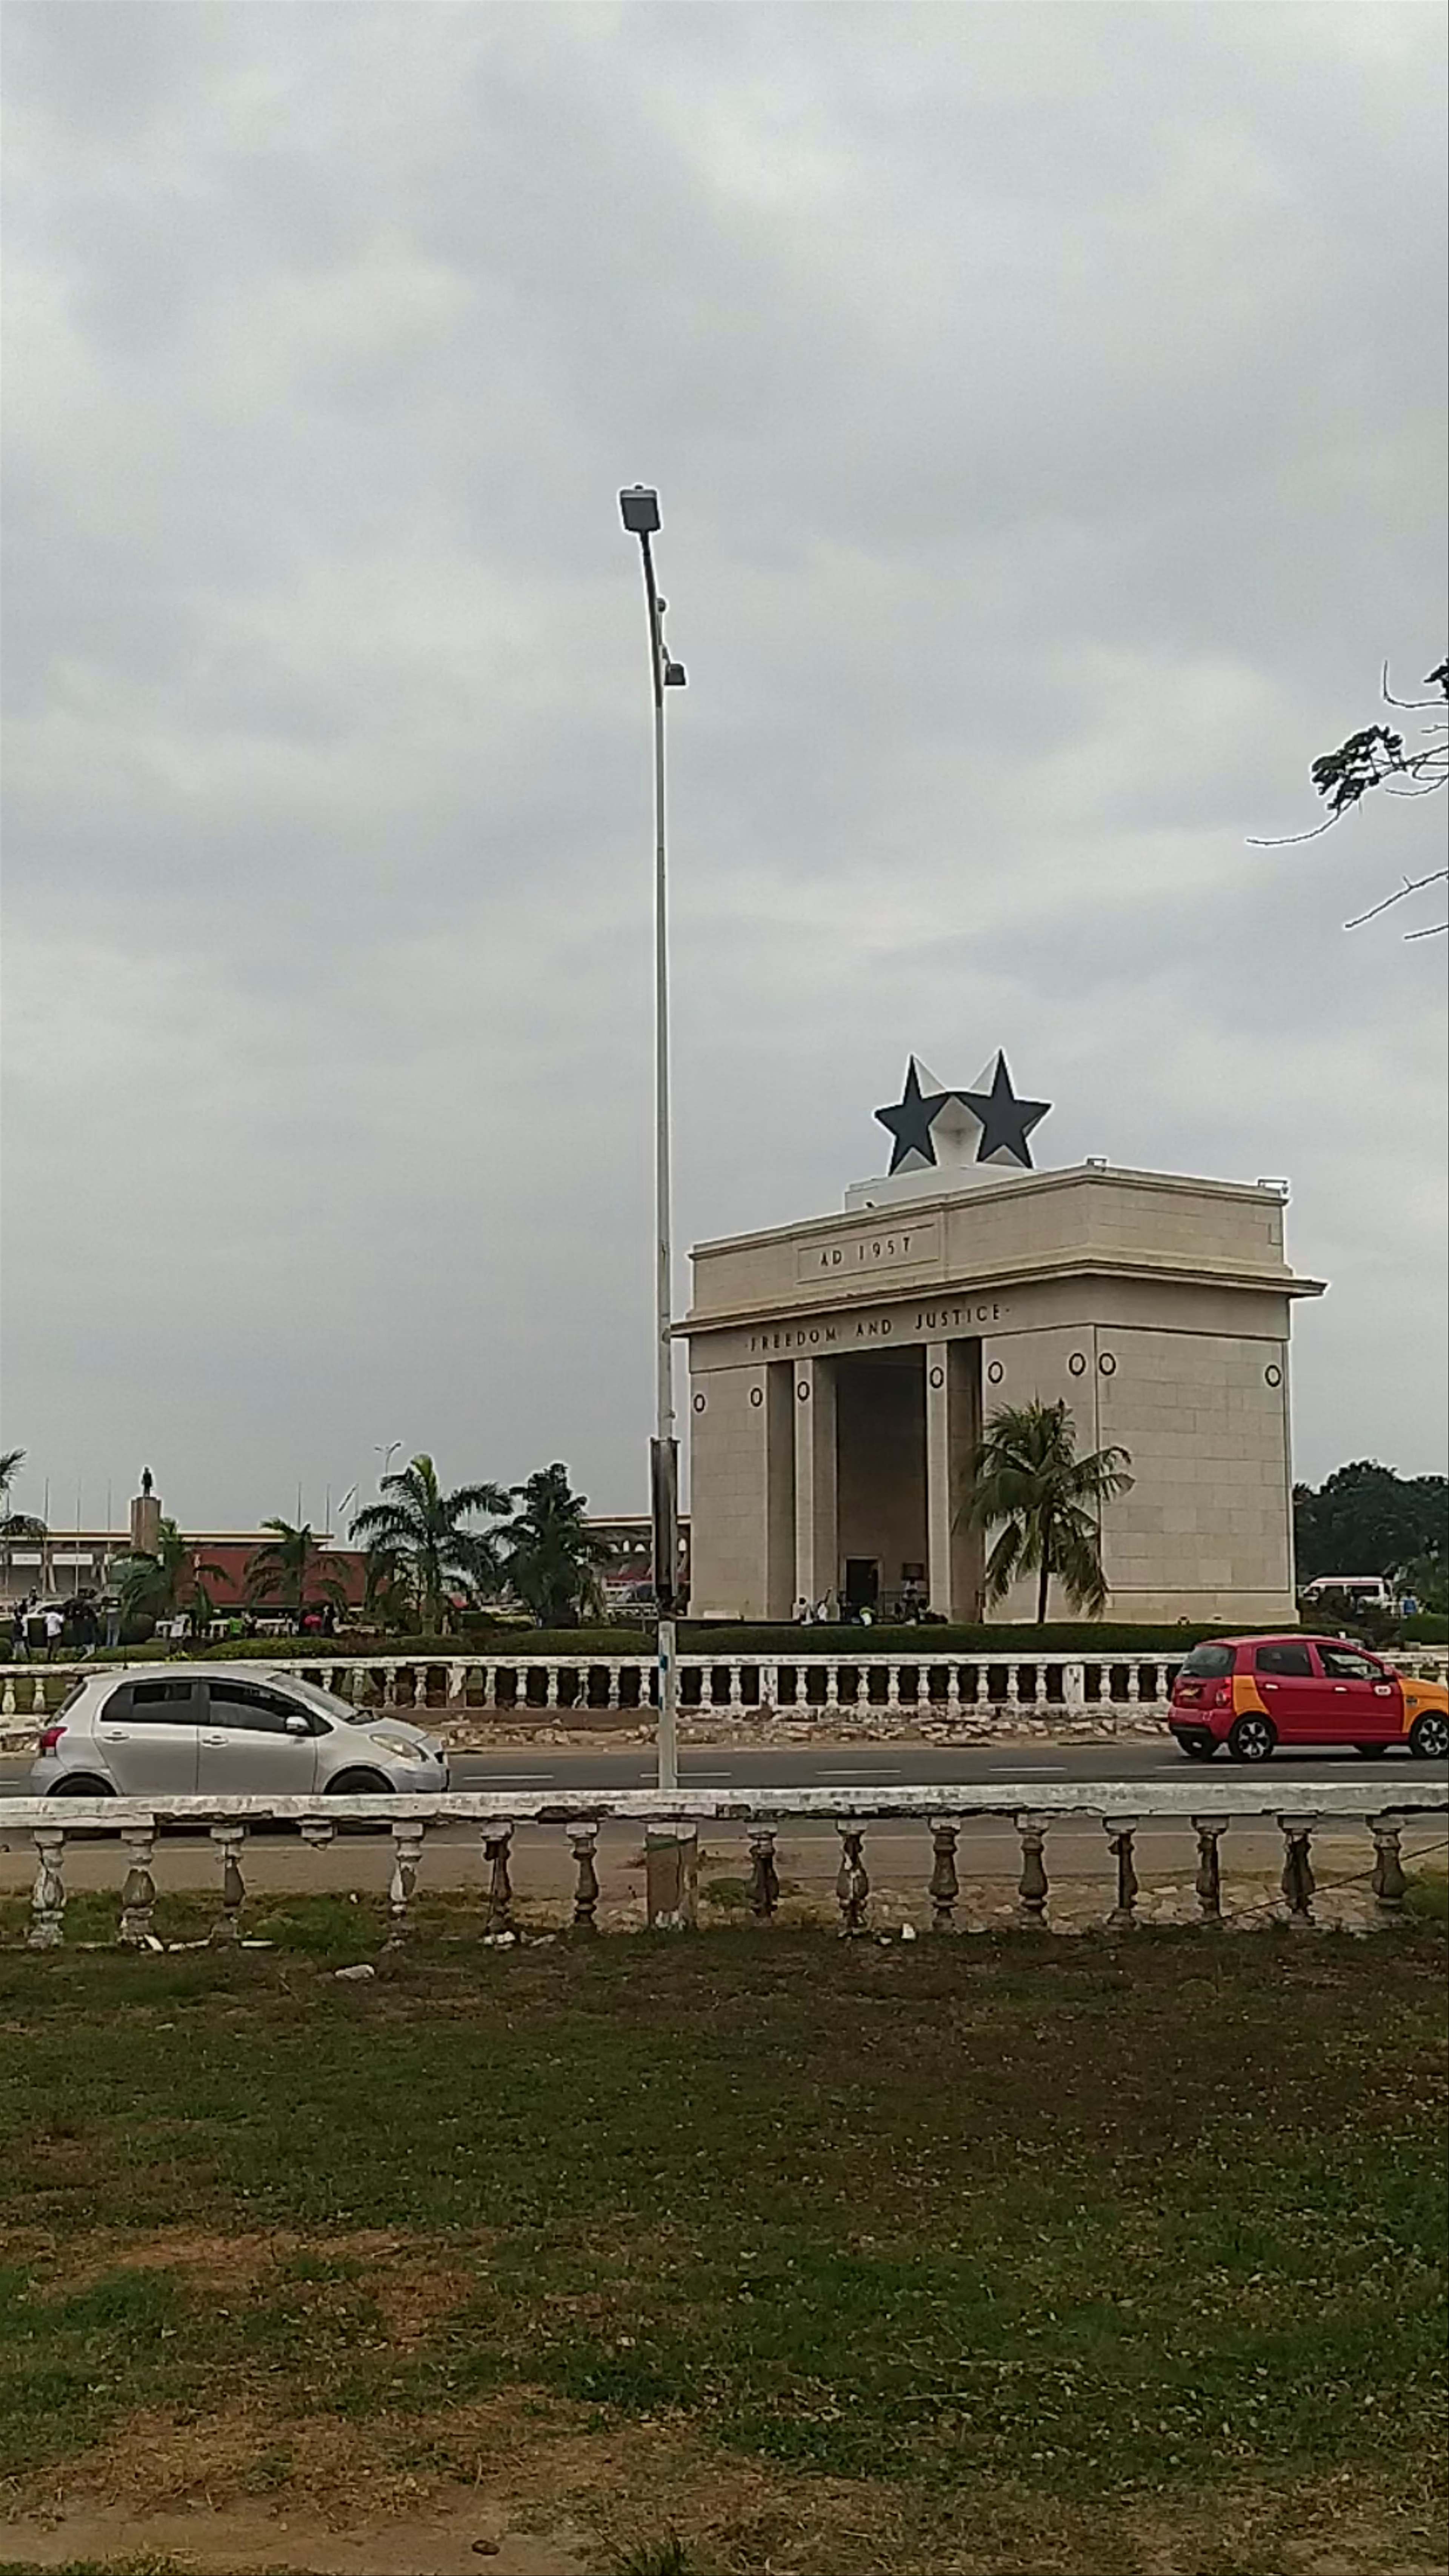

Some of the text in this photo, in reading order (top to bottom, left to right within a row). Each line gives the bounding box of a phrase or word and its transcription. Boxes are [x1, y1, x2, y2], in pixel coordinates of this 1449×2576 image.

[820, 1236, 910, 1266] AD 1957
[751, 1304, 1000, 1352] FREEDOM AND JUSTICE
